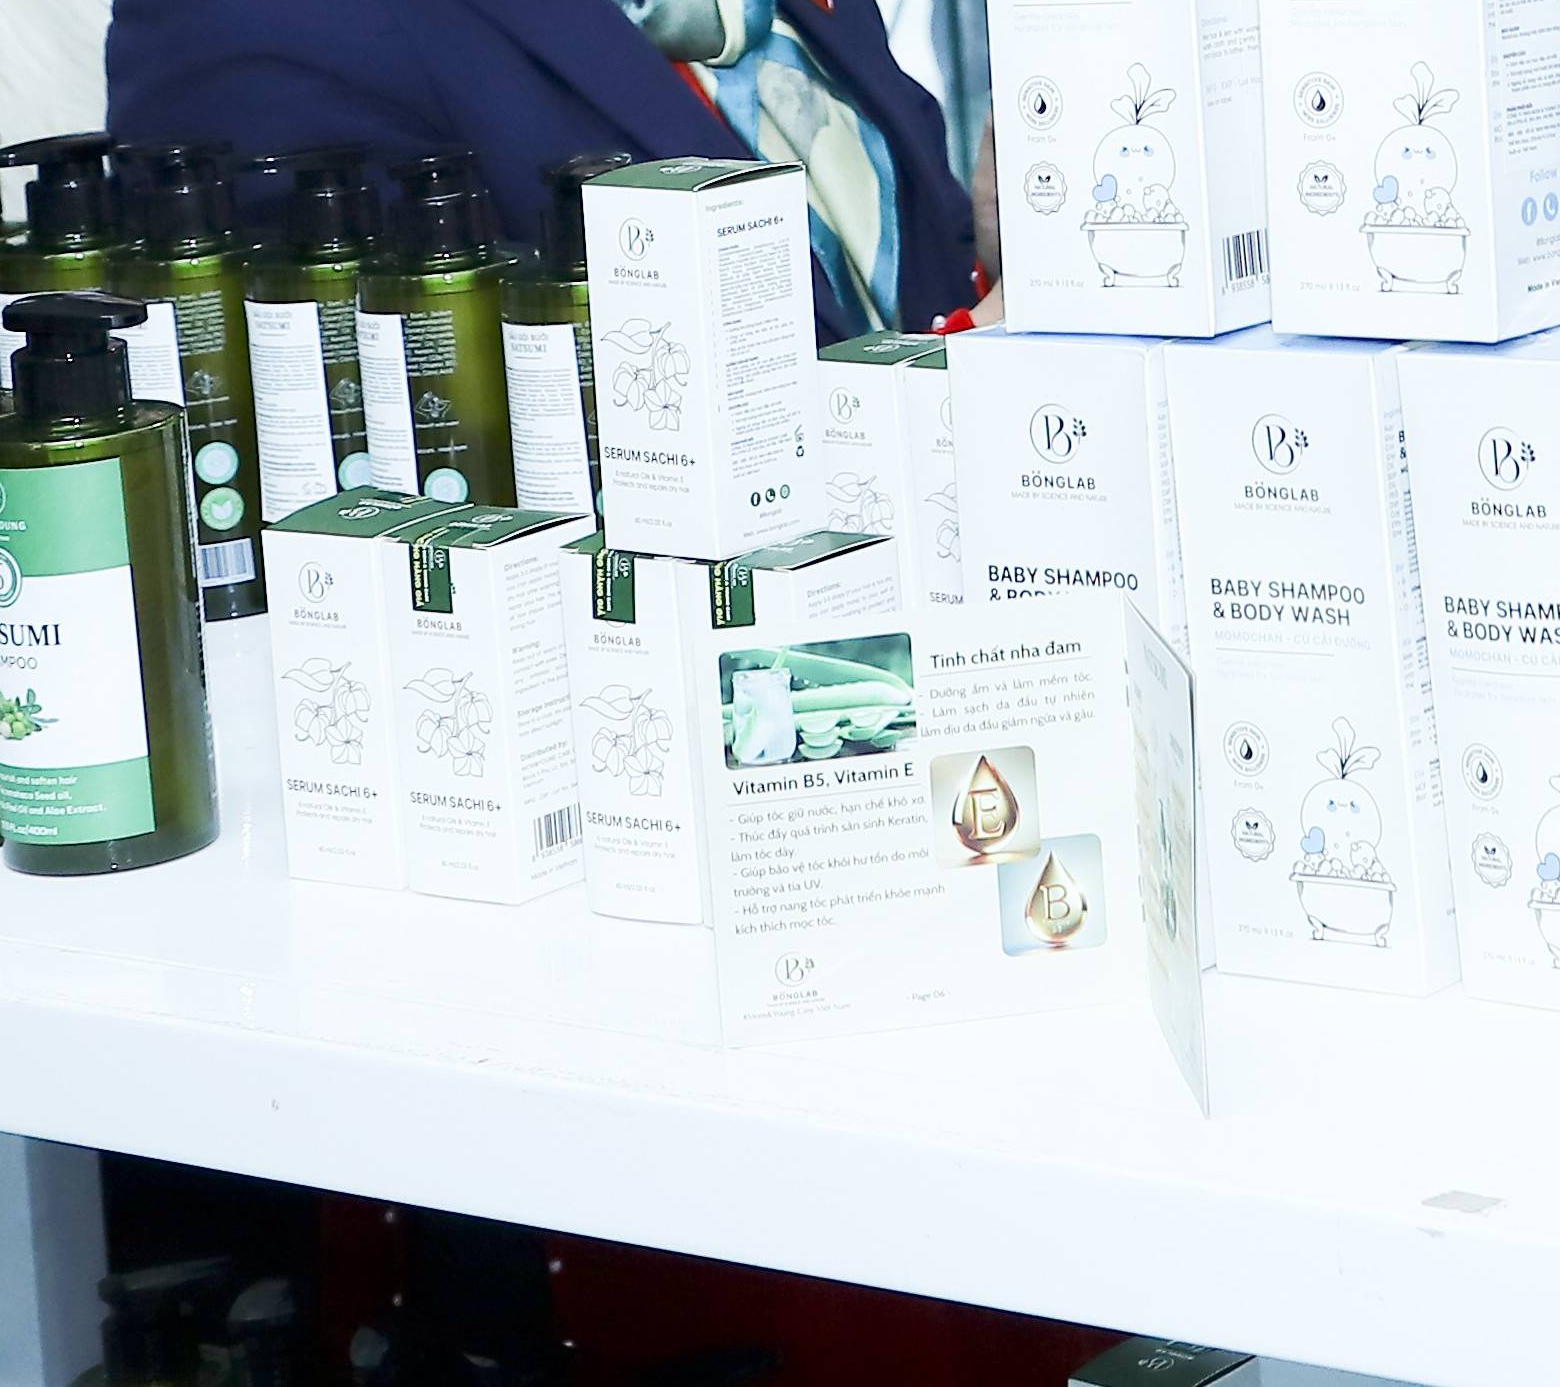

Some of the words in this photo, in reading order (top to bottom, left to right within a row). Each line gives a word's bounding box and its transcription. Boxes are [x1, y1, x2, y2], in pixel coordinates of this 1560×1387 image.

[604, 445, 641, 463] SERUM
[644, 451, 679, 466] SACHI
[680, 454, 696, 467] 6+
[1021, 470, 1096, 490] BÖNGLAB
[1244, 481, 1319, 502] BÖNGLAB
[1471, 497, 1547, 519] BÖNGLAB
[988, 564, 1038, 584] BABY
[1044, 567, 1139, 591] SHAMPOO
[1211, 578, 1262, 598] BABY
[1268, 581, 1365, 605] SHAMPOO
[1213, 601, 1225, 619] &
[1231, 602, 1284, 622] BODY
[1291, 605, 1350, 626] WASH
[1444, 595, 1490, 618] BABY
[1447, 620, 1458, 638] &
[1463, 622, 1513, 644] BODY
[971, 645, 1005, 665] chất
[1010, 644, 1040, 660] nha
[1045, 640, 1081, 656] đam
[286, 778, 324, 796] SERUM
[326, 782, 361, 798] SACHI
[363, 785, 378, 799] 6+
[733, 776, 798, 796] Vitamin
[804, 772, 830, 789] B5,
[834, 764, 899, 784] Vitamin
[904, 762, 914, 777] E
[409, 790, 448, 808] SERUM
[449, 795, 485, 812] SACHI
[487, 799, 502, 813] 6+
[586, 810, 622, 829] SERUM
[625, 815, 663, 833] SACHI
[664, 819, 682, 835] 6+
[1039, 883, 1071, 921] B
